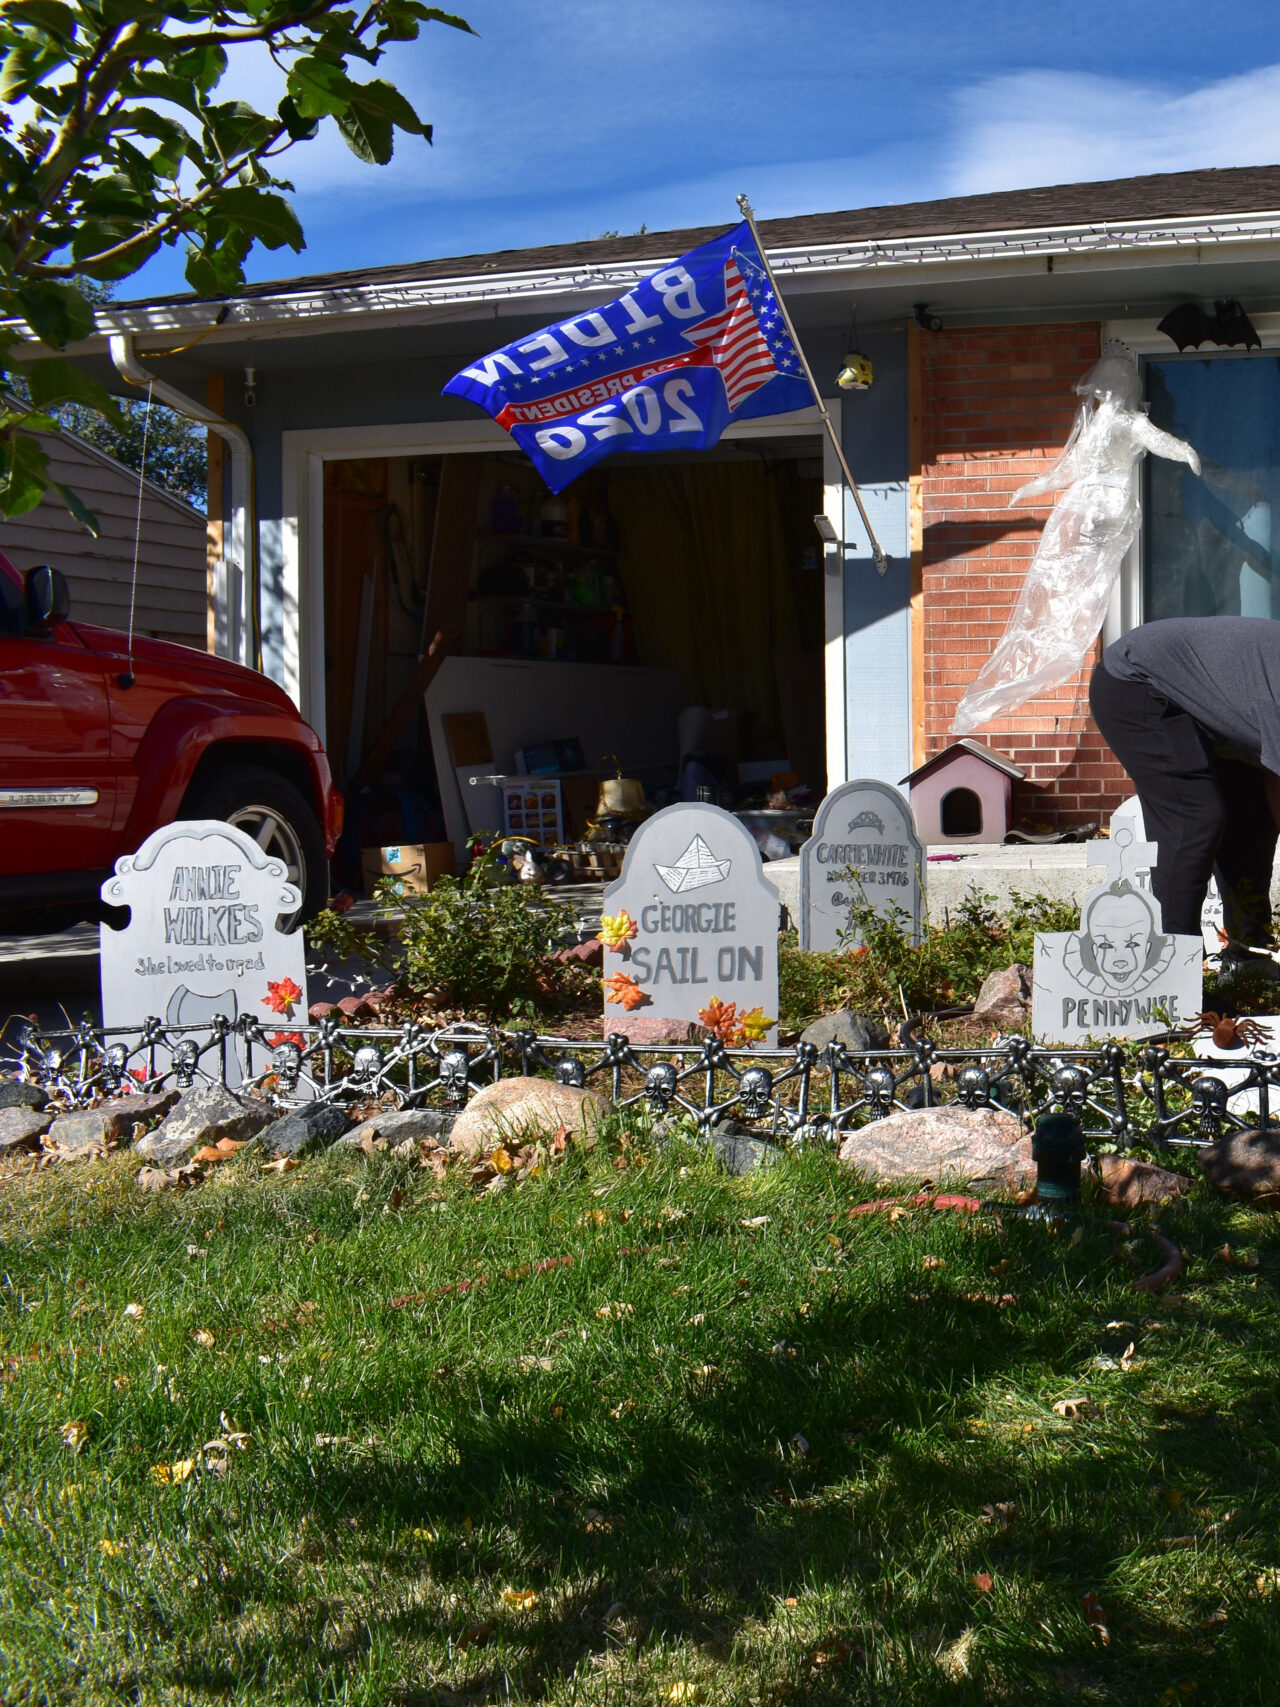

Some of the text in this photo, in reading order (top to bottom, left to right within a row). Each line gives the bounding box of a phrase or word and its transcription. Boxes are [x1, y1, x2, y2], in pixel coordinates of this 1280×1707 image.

[8, 793, 81, 803] LIBERTY
[817, 843, 909, 868] CARRIE WHITE
[169, 865, 241, 901] ANNIE
[163, 903, 263, 946] WILKES
[641, 902, 736, 934] GEORGIE
[134, 956, 166, 976] She
[206, 953, 224, 971] to
[631, 945, 764, 985] SAIL ON
